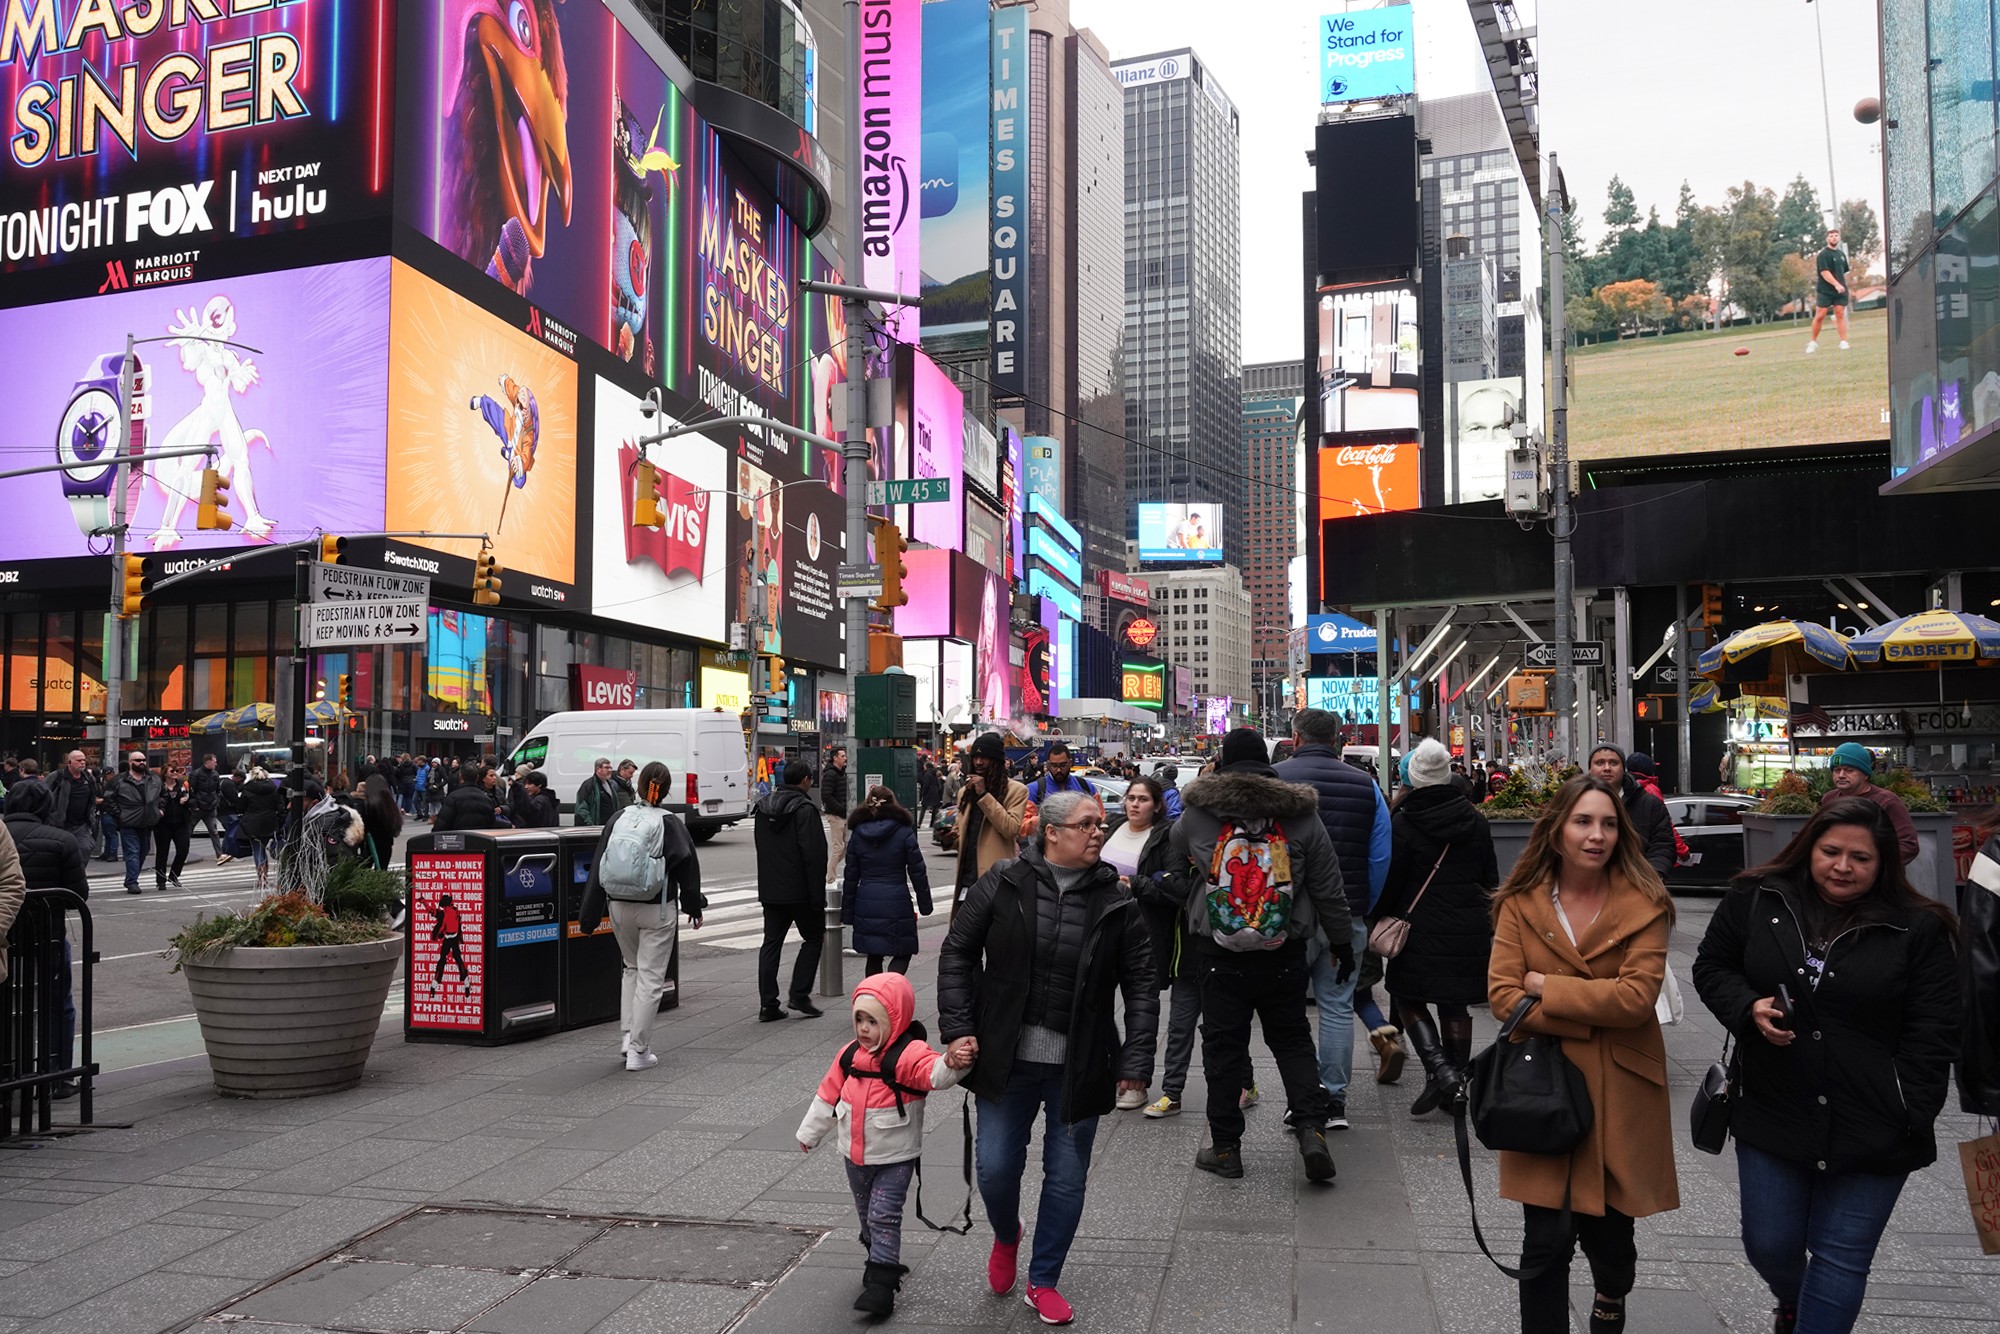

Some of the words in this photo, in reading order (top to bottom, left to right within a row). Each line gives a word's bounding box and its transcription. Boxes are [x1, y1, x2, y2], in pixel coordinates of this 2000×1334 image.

[1327, 18, 1354, 33] We
[1327, 30, 1375, 49] Stand
[1381, 29, 1404, 43] for
[1327, 47, 1405, 68] Progress
[1115, 67, 1155, 84] llianz
[12, 32, 310, 168] SINGER
[994, 27, 1018, 172] TIMES
[258, 167, 293, 185] NEXT
[295, 162, 321, 179] DAY
[863, 107, 891, 258] amazon
[252, 184, 327, 223] hulu
[0, 195, 119, 262] TONIGHT
[125, 180, 214, 243] FOX
[734, 188, 762, 244] THE
[135, 250, 200, 269] MARRIOTT
[699, 184, 789, 331] MASKED
[134, 266, 192, 285] MARQUIS
[994, 195, 1018, 375] SQUARE
[545, 317, 577, 343] MARRIOTT
[545, 330, 574, 354] MARQUIS
[704, 282, 787, 399] SINGER
[698, 364, 739, 418] TONIGHT
[771, 428, 788, 454] hulu
[1336, 444, 1398, 466] Coca-Cola
[890, 484, 903, 501] W
[911, 482, 929, 500] 45
[937, 481, 946, 493] St
[384, 550, 440, 574] #SwatchXDBZ
[323, 568, 374, 588] PEDESTRIAN
[376, 576, 400, 591] FLOW
[403, 580, 424, 594] ZONE
[316, 606, 366, 622] PEDESTRIAN
[368, 604, 393, 619] FLOW
[396, 604, 420, 618] ZONE
[316, 626, 334, 640] KEEP
[336, 624, 370, 639] MOVING
[1341, 627, 1377, 639] Pruden
[1903, 620, 1957, 634] SABRETT
[1536, 650, 1556, 660] ONE
[1572, 649, 1596, 659] WAY
[1888, 643, 1971, 657] SABRETT
[916, 676, 929, 684] usic
[1322, 680, 1349, 694] NOW
[716, 693, 739, 707] INVICTA
[1322, 696, 1349, 710] NOW
[434, 718, 463, 731] swatch
[791, 720, 814, 731] SEPHORA
[1919, 712, 1971, 730] FOOD
[415, 861, 430, 870] JAM
[435, 861, 451, 870] BAD
[455, 861, 482, 870] MONEY
[415, 871, 438, 879] KEEP
[440, 871, 456, 879] THE
[458, 871, 482, 880] FAITH
[431, 882, 443, 890] JEAN
[435, 892, 440, 900] IT
[474, 902, 482, 911] IT
[415, 913, 428, 921] THEY
[461, 923, 482, 932] CHINE
[499, 931, 525, 943] TIMES
[526, 927, 557, 940] SQUARE
[415, 933, 430, 941] MAN
[463, 934, 482, 943] IRROR
[414, 963, 426, 971] I'LL
[429, 963, 437, 971] BE
[467, 965, 482, 973] ABC
[414, 973, 429, 981] BEAT
[447, 984, 454, 992] IN
[414, 1003, 481, 1014] THRILLER
